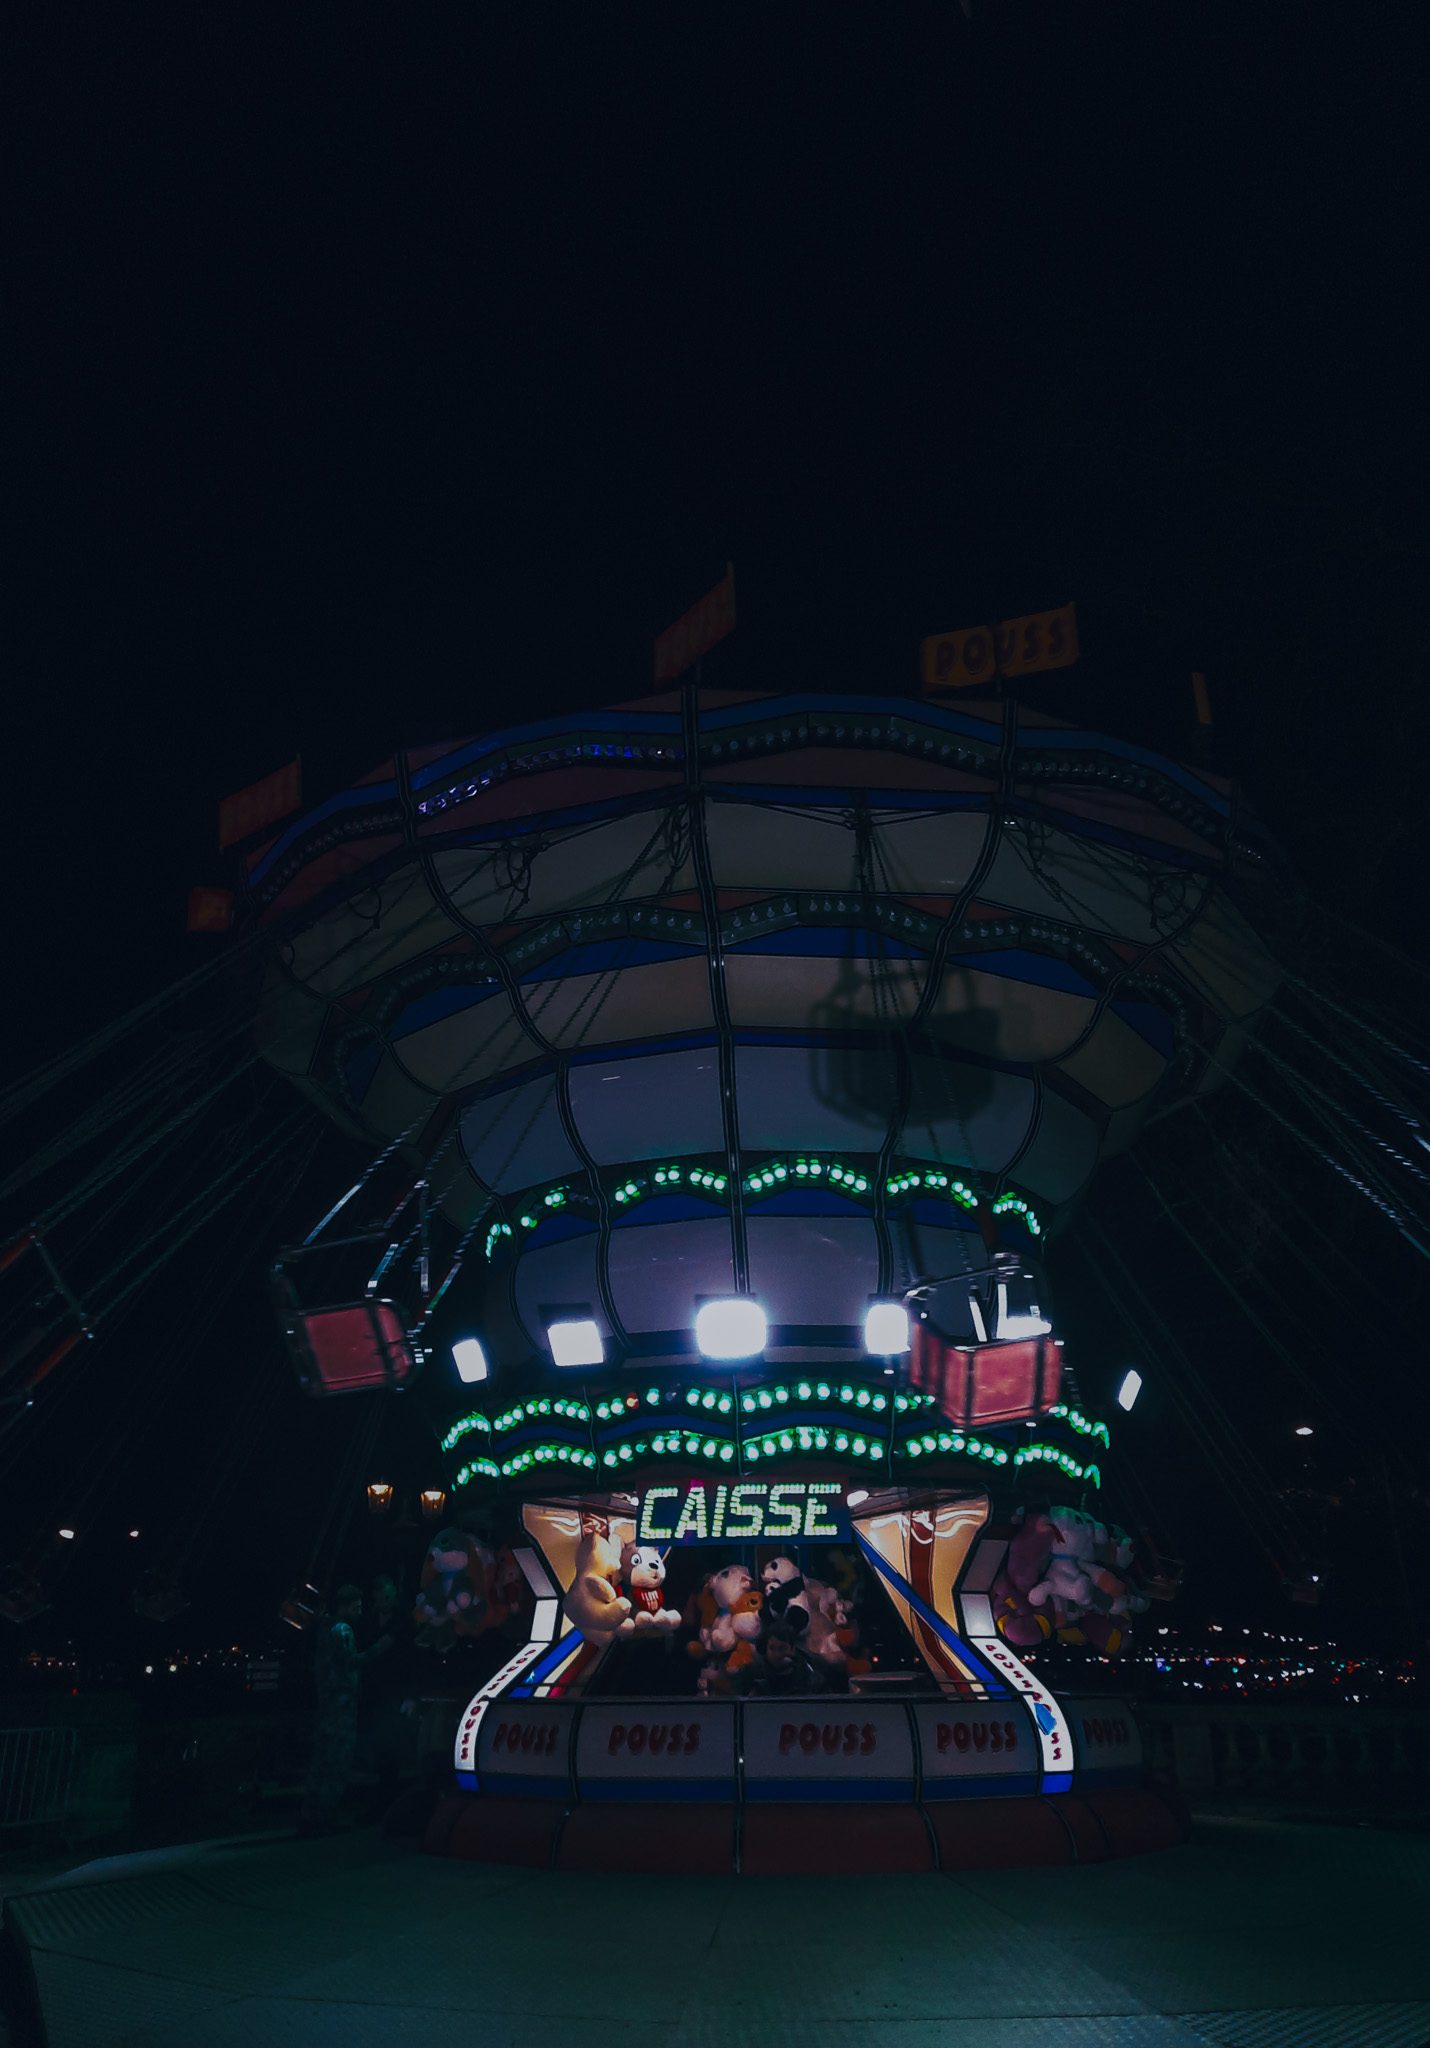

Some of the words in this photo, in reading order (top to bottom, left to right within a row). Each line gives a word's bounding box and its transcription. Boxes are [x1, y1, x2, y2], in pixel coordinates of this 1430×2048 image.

[934, 614, 1065, 680] POUSS
[641, 1483, 841, 1539] CAISSE
[494, 1723, 558, 1754] POUSS
[608, 1723, 700, 1755] POUSS
[779, 1722, 877, 1755] POUSS
[937, 1721, 1017, 1754] POUSS
[1033, 1692, 1061, 1759] PSS
